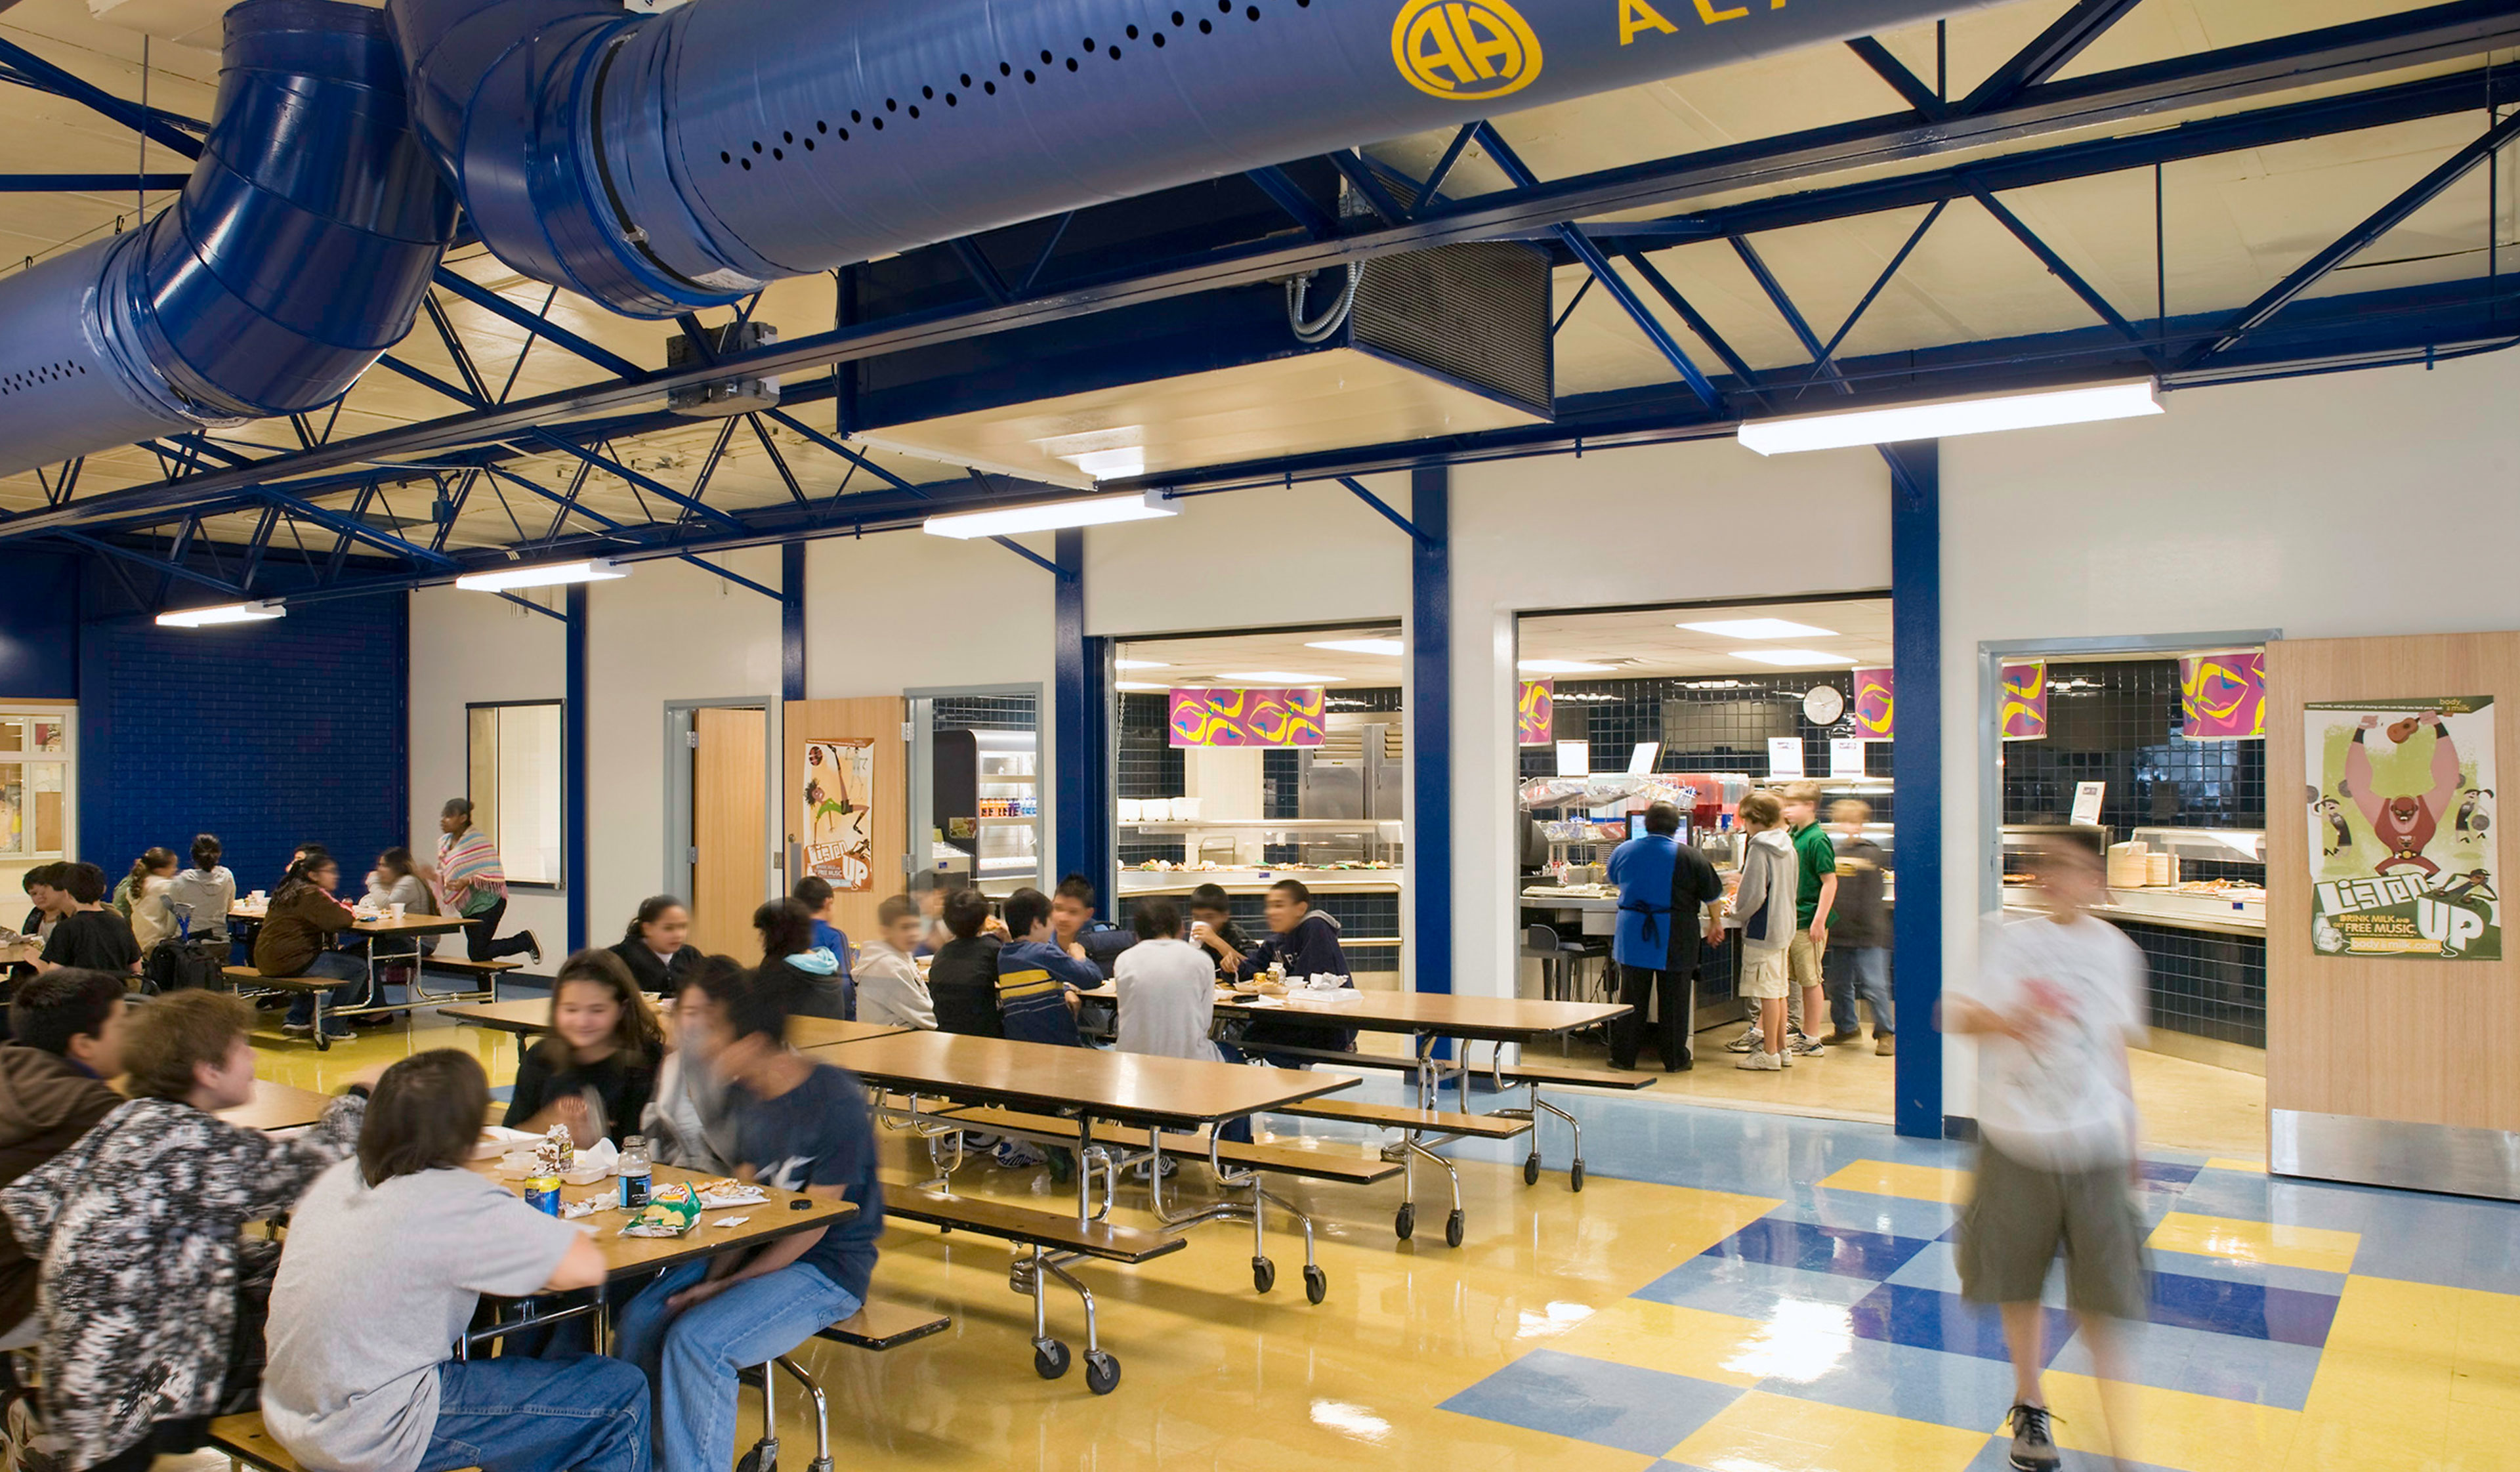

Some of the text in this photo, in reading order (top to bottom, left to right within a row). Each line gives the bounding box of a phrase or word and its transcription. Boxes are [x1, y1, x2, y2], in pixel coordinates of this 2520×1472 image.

[843, 854, 868, 887] UP
[2340, 914, 2369, 923] DRINK
[2371, 915, 2395, 923] MILK
[2417, 896, 2484, 951] UP
[2345, 923, 2372, 933] FREE
[2352, 939, 2380, 950] body
